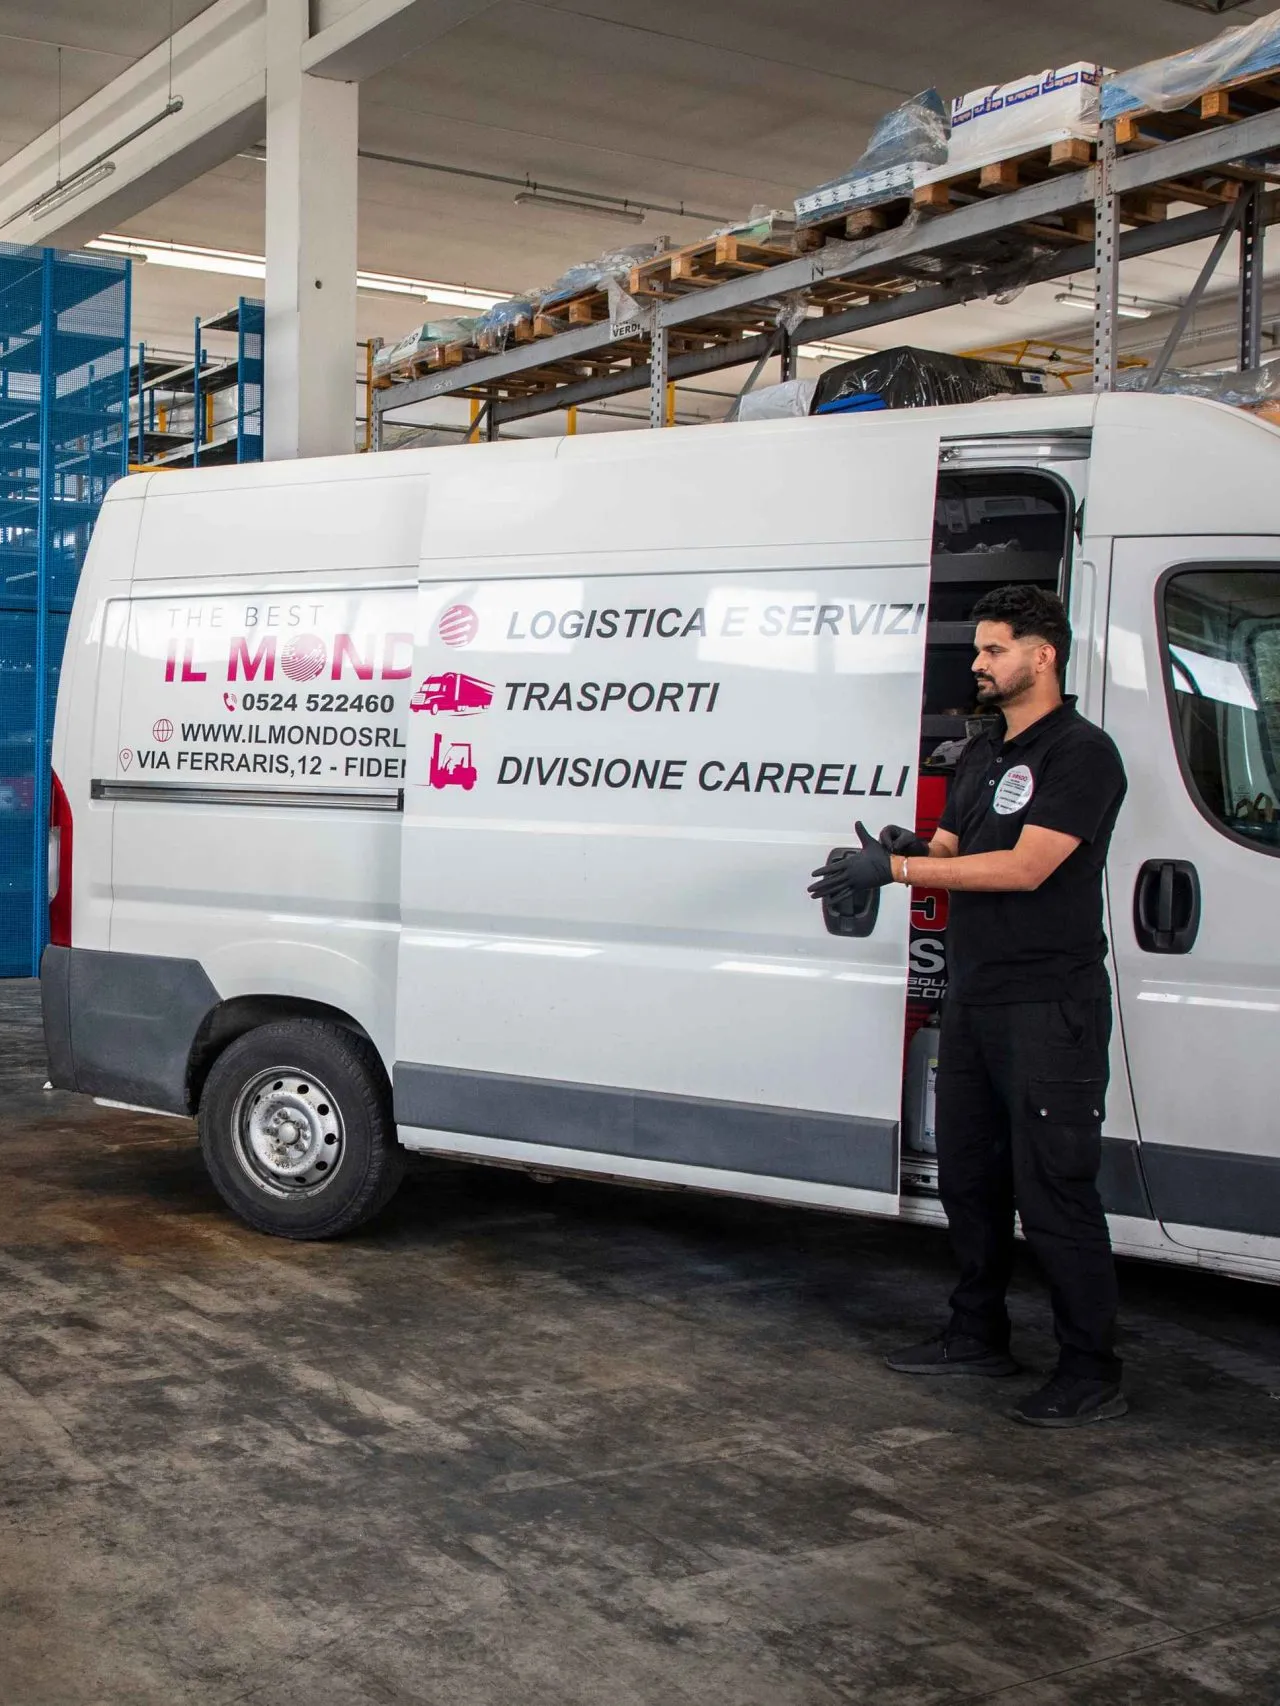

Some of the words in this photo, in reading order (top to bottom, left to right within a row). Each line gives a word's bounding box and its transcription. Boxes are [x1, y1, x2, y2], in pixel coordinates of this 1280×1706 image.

[167, 607, 224, 628] THE
[245, 605, 324, 627] BEST
[507, 607, 706, 640] LOGISTICA
[720, 606, 750, 637] E
[759, 603, 926, 636] SERVIZI
[165, 637, 207, 682] IL
[242, 693, 297, 711] 0524
[306, 693, 395, 713] 522460
[504, 682, 720, 712] TRASPORTI
[181, 723, 406, 747] WWW.ILMONDOSRL
[137, 750, 170, 769] VIA
[177, 751, 322, 777] FERRARIS,12
[497, 756, 687, 790] DIVISIONE
[698, 760, 910, 797] CARRELLI
[908, 976, 948, 987] SQU
